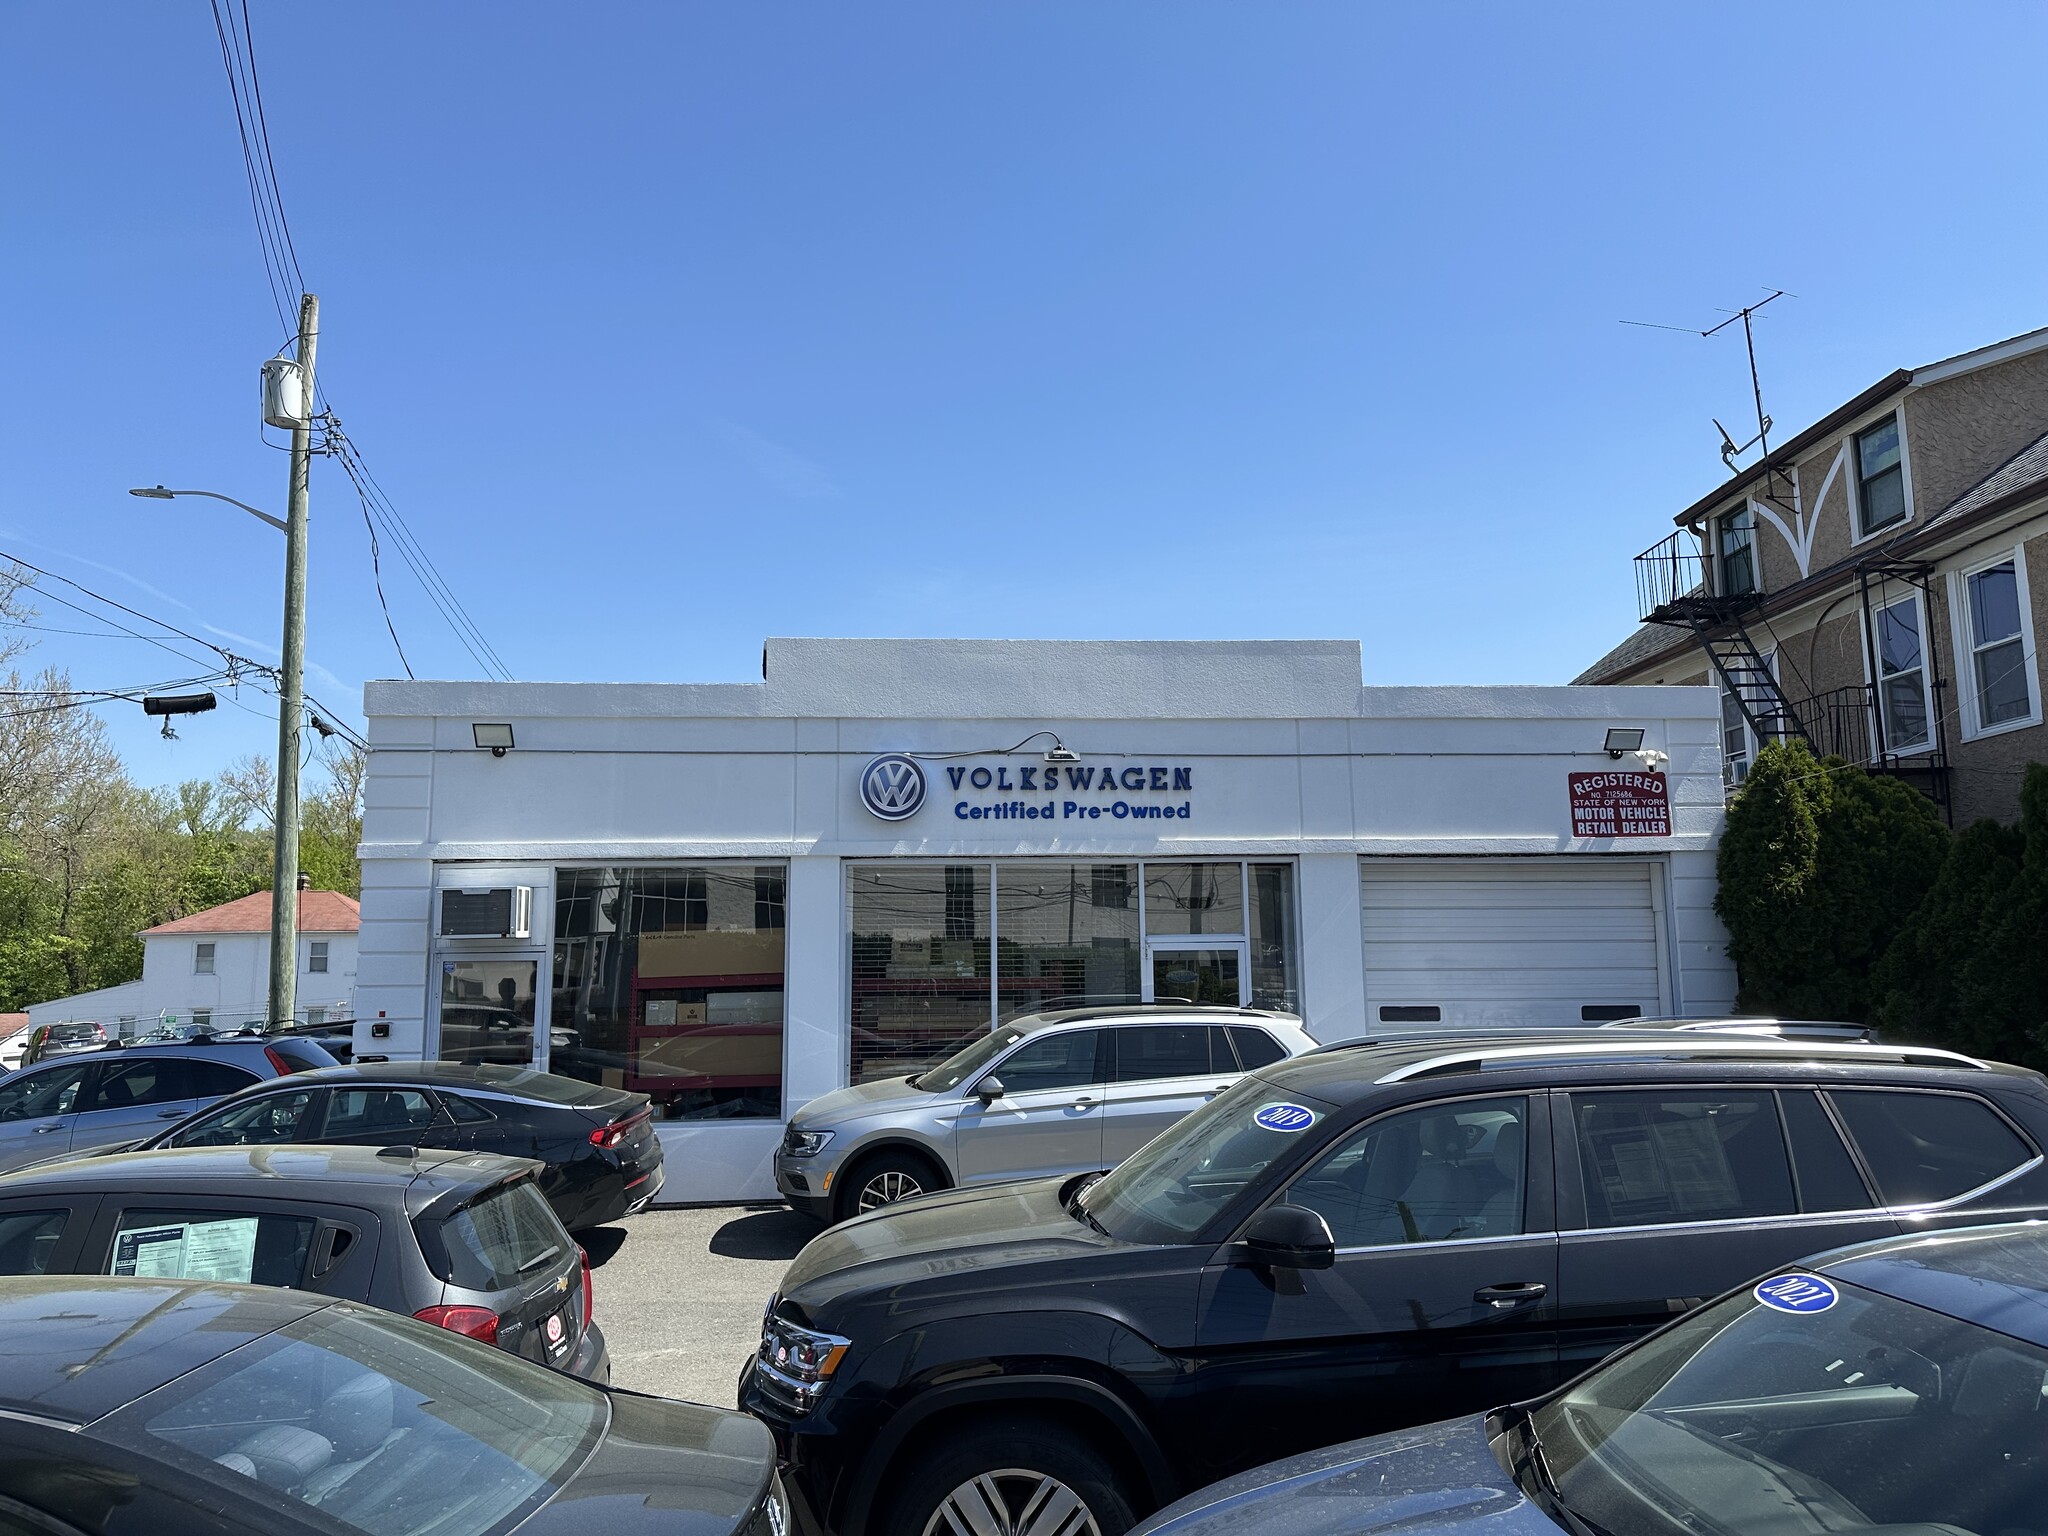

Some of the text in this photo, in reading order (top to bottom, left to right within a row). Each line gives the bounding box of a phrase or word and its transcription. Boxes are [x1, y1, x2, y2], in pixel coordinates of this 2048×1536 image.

[947, 766, 1193, 791] VOLKSWAGEN
[1573, 774, 1663, 796] REGISTERED
[954, 801, 1191, 820] Certified Pre-Owned
[1574, 807, 1667, 820] MOTOR VEHICLE
[1577, 821, 1667, 834] RETAIL DEALER
[1259, 1107, 1309, 1125] 2019
[1760, 1277, 1831, 1306] 2021
